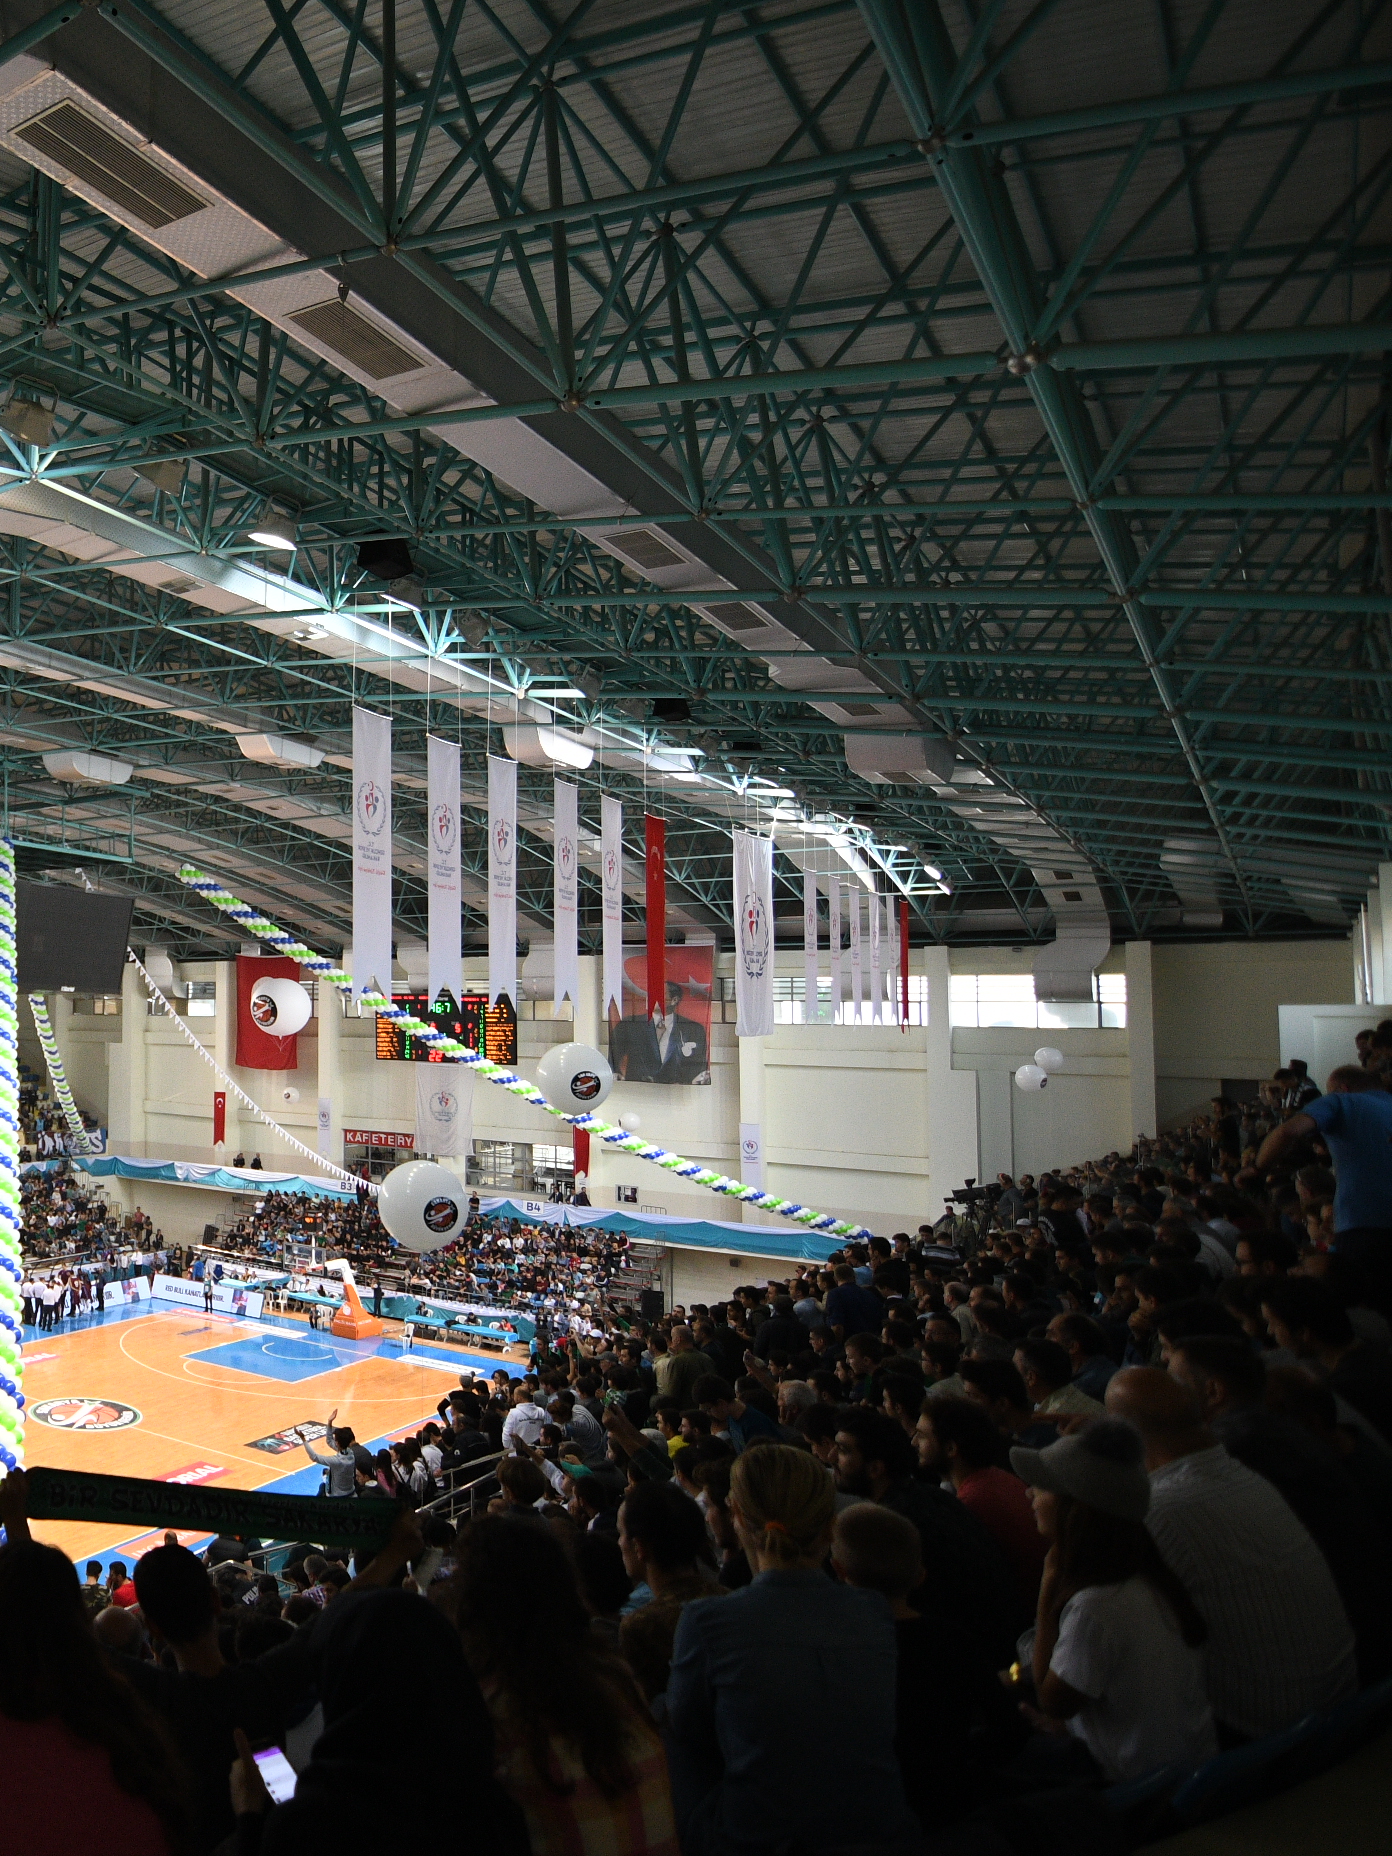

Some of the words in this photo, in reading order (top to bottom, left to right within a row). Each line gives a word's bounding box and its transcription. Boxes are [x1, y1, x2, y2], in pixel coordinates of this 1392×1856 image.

[346, 1130, 413, 1148] KAFETERY
[340, 1181, 352, 1190] B3
[526, 1202, 541, 1212] B4
